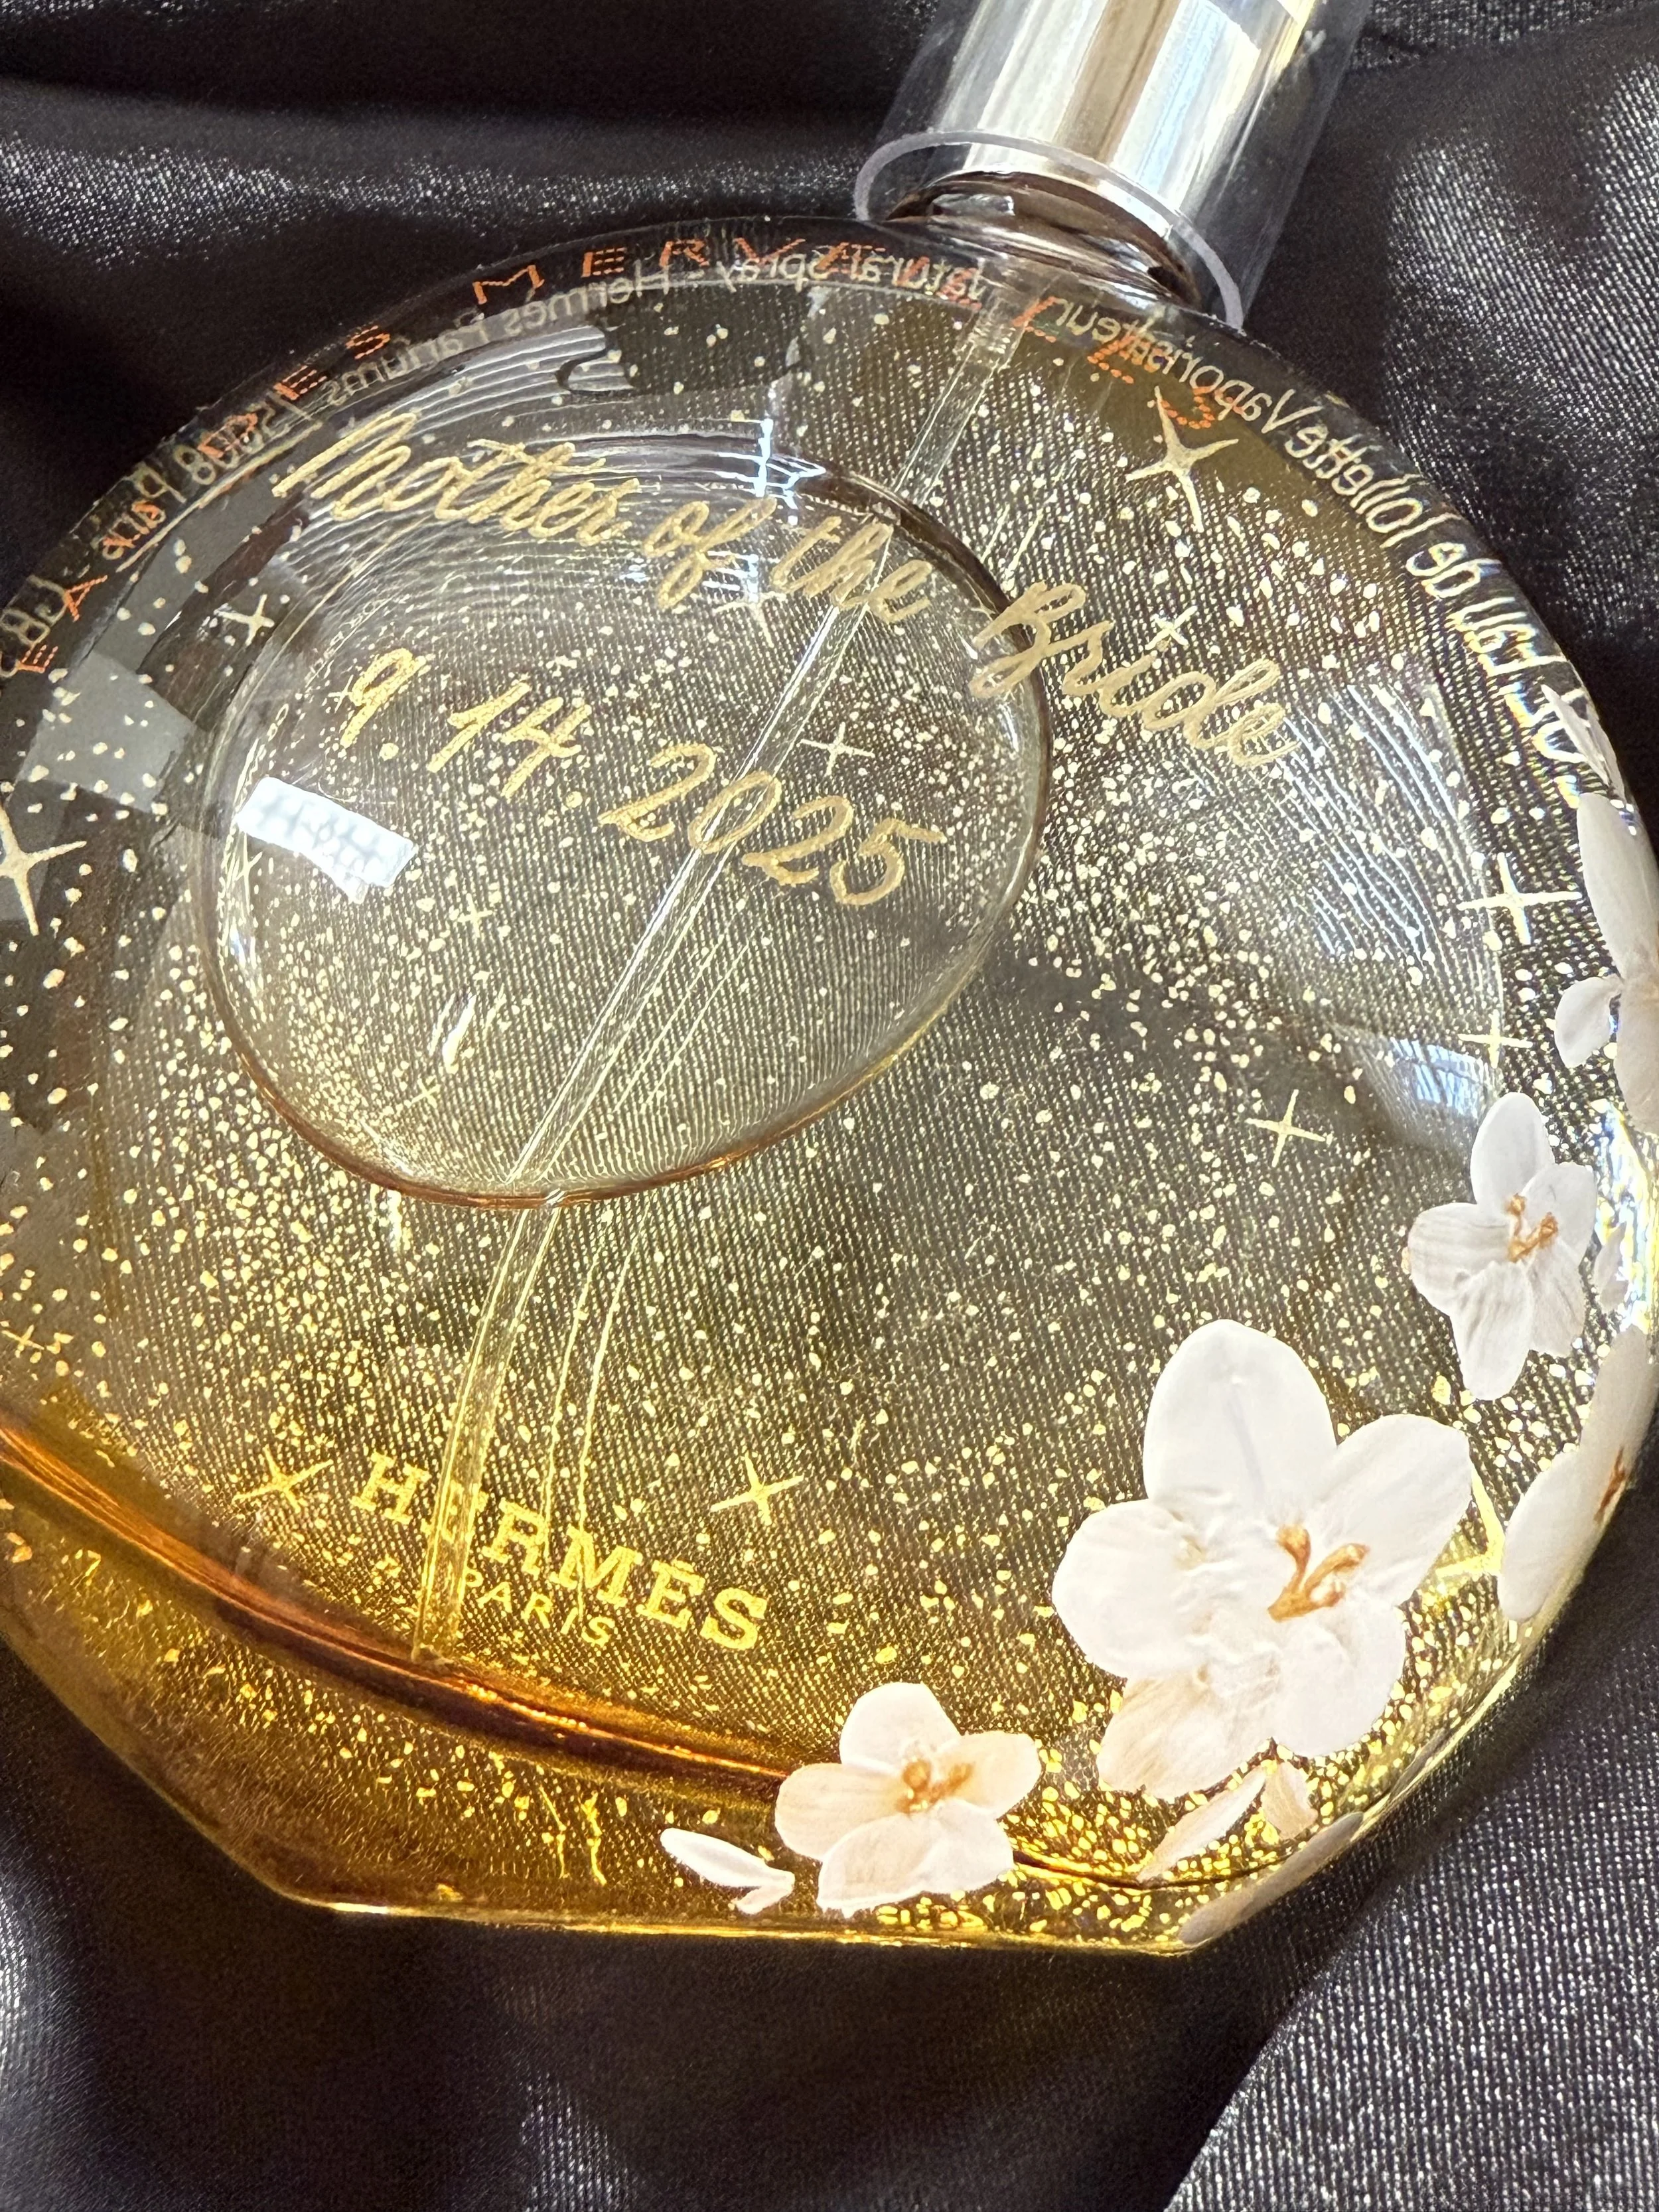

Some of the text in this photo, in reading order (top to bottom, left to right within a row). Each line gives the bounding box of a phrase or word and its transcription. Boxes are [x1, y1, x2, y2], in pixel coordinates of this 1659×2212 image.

[271, 411, 1302, 768] Mother of the Bride
[597, 741, 946, 905] 2025
[348, 1451, 769, 1651] HERMÈS
